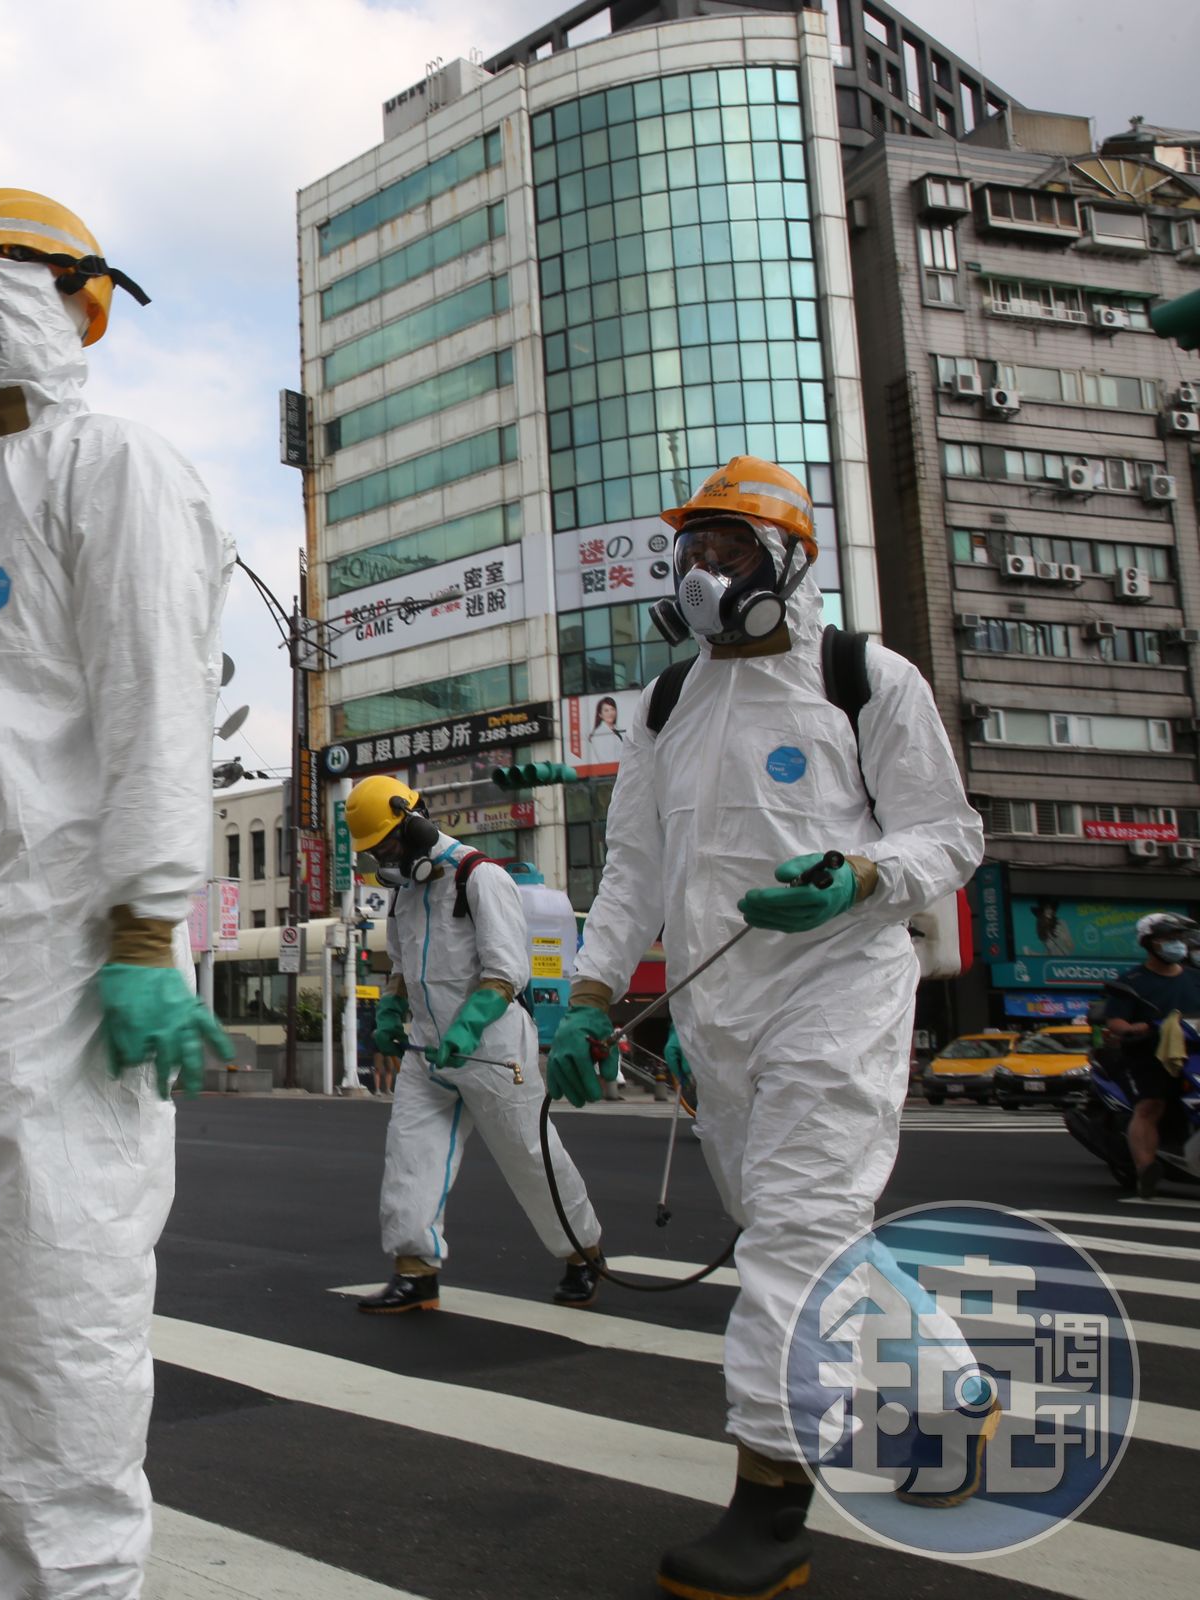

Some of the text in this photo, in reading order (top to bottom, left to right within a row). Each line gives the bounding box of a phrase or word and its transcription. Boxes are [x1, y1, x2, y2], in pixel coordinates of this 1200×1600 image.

[464, 561, 504, 592] 密室
[344, 597, 393, 625] ESCAPE
[465, 588, 506, 618] 逃脫
[355, 617, 394, 641] GAME
[1052, 965, 1119, 980] watsons
